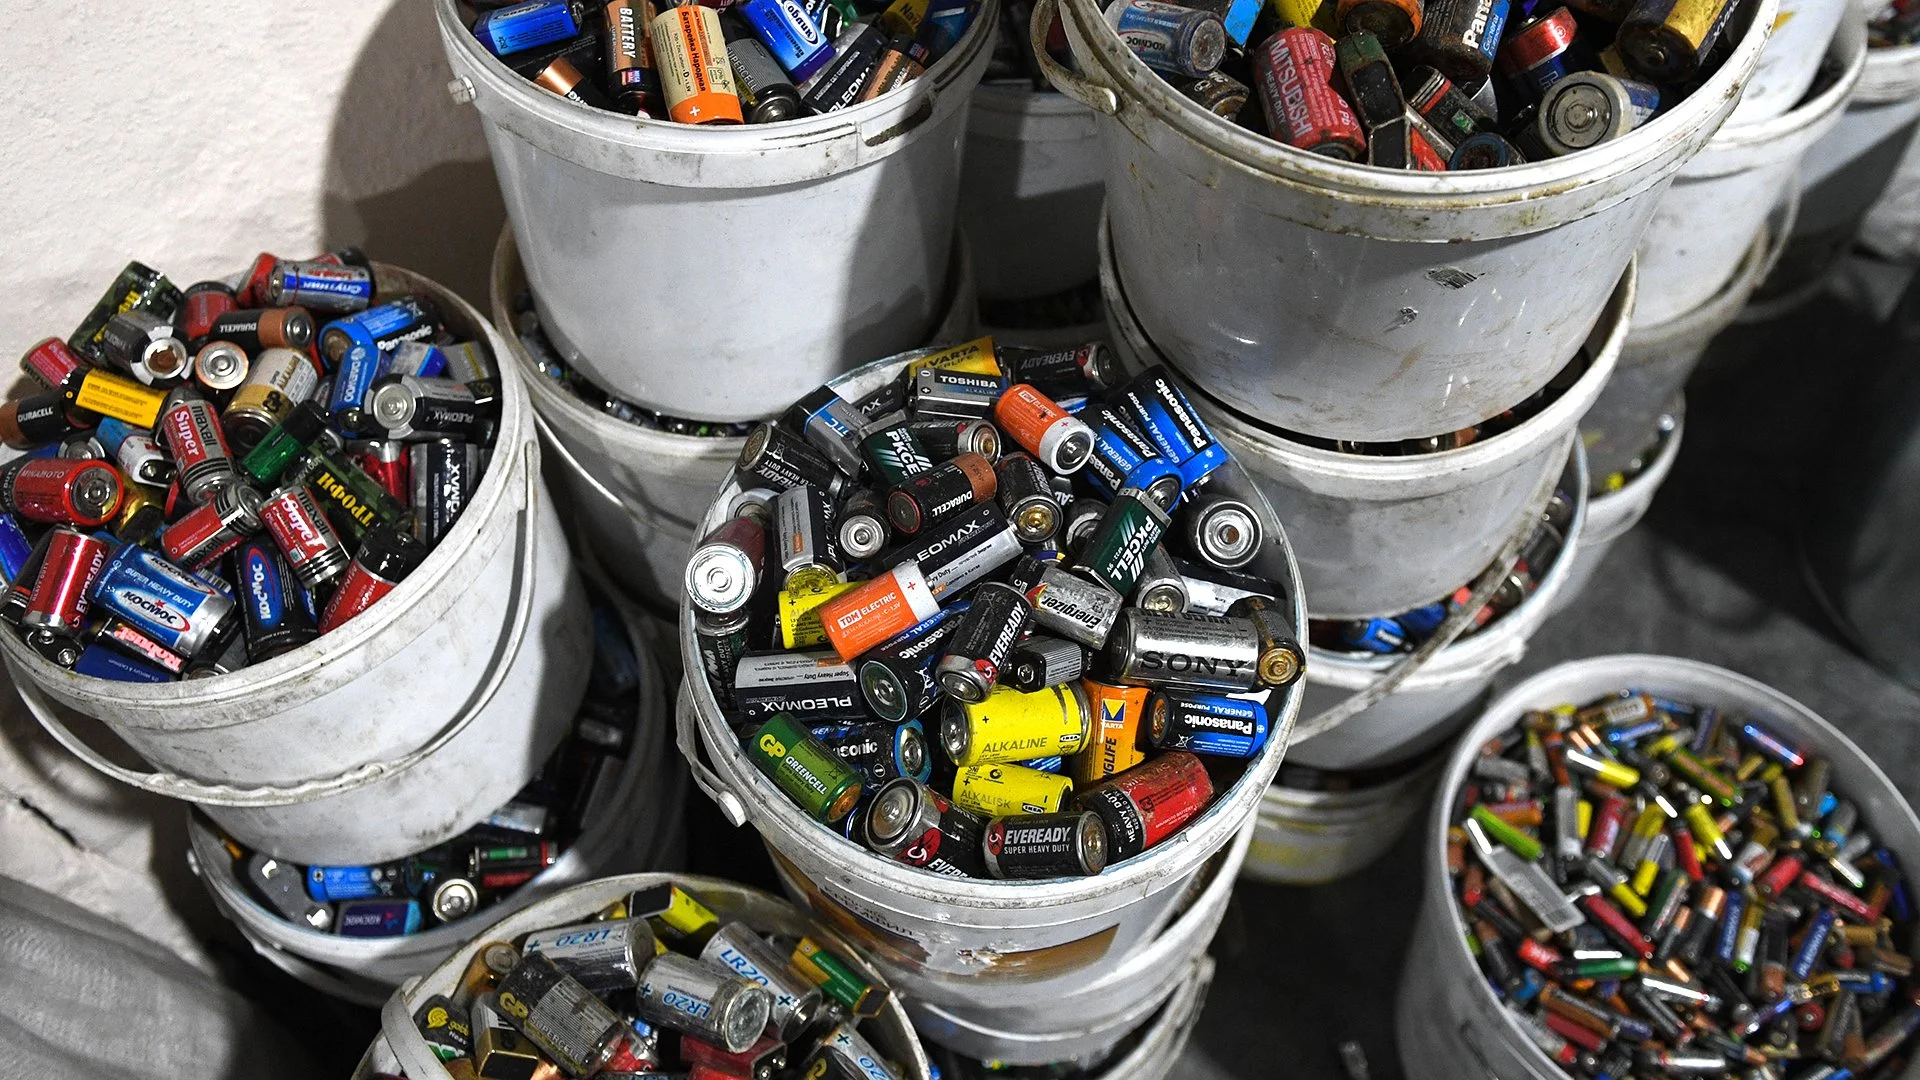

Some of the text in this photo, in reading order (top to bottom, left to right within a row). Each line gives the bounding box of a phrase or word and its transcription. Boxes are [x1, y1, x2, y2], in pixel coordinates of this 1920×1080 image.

[619, 7, 636, 58] BATTERY
[1126, 36, 1166, 51] КОСМОС
[1482, 13, 1501, 51] General
[681, 11, 706, 92] Батарейка Народная
[727, 46, 758, 91] SUPERCELL
[836, 51, 861, 76] CORPORATION
[1265, 72, 1287, 125] HEAVY DUTY
[1269, 38, 1313, 137] MITSUBISHI
[219, 322, 257, 335] DURACELL
[376, 324, 433, 351] Panasonic
[928, 344, 980, 365] VARTA
[934, 355, 974, 370] ERLIFE
[1020, 350, 1076, 369] EVEREADY
[344, 360, 362, 402] DAEWOO
[940, 375, 998, 388] TOSHIBA
[17, 406, 54, 423] DURACELL
[432, 410, 474, 423] PLEOMAX
[1127, 391, 1151, 423] PURPOSE
[1155, 377, 1207, 449] Panasonic
[174, 410, 200, 457] Super
[191, 405, 218, 447] maxell
[1101, 409, 1157, 458] Panasonic
[1151, 421, 1180, 464] GENERAL
[886, 431, 920, 475] PKCE
[1100, 437, 1133, 471] GENERAL
[19, 468, 66, 480] MINAMOTO
[757, 465, 800, 490] READY
[764, 459, 801, 483] HEAVY DUTY
[1088, 454, 1122, 491] Panas
[298, 491, 329, 536] maxell
[316, 471, 377, 528] ТРОФИ
[931, 490, 973, 517] DURACELL
[280, 493, 327, 548] Super
[184, 535, 225, 570] maxell
[916, 519, 980, 564] EOMAX
[1110, 515, 1156, 583] PKCELL
[76, 547, 107, 614] EVEREADY
[124, 567, 195, 608] SUPER HEAVY DUTY
[937, 568, 951, 580] Duty
[122, 591, 178, 625] КОСМОС
[251, 563, 272, 620] КОСМОС
[838, 592, 897, 628] TDM ELECTRIC
[1042, 595, 1102, 630] Energizer
[879, 608, 949, 652] GENERAL PURPOSE
[989, 601, 1027, 665] EVEREADY
[113, 625, 184, 672] Robust
[1140, 650, 1248, 677] SONY
[817, 671, 834, 679] Heavy
[763, 696, 852, 712] PLEOMAX
[1180, 702, 1253, 717] GENERAL PURPOSE
[1184, 713, 1253, 735] Panasonic
[759, 734, 786, 758] GP
[832, 739, 878, 758] sonic
[981, 737, 1048, 754] ALKALINE
[1103, 737, 1117, 778] NGLIFE
[785, 755, 828, 795] GREENCELL
[793, 773, 806, 785] Heavy
[960, 789, 1011, 810] ALKALISK
[1102, 789, 1136, 843] HEAVY DUTY
[1004, 827, 1071, 845] EVEREADY
[1004, 844, 1070, 854] SUPER HEAVY DUTY
[555, 927, 610, 947] LR20
[720, 948, 768, 987] LR20
[500, 992, 529, 1019] GP
[663, 992, 711, 1019] LR20
[531, 1015, 580, 1061] SUPERCELL
